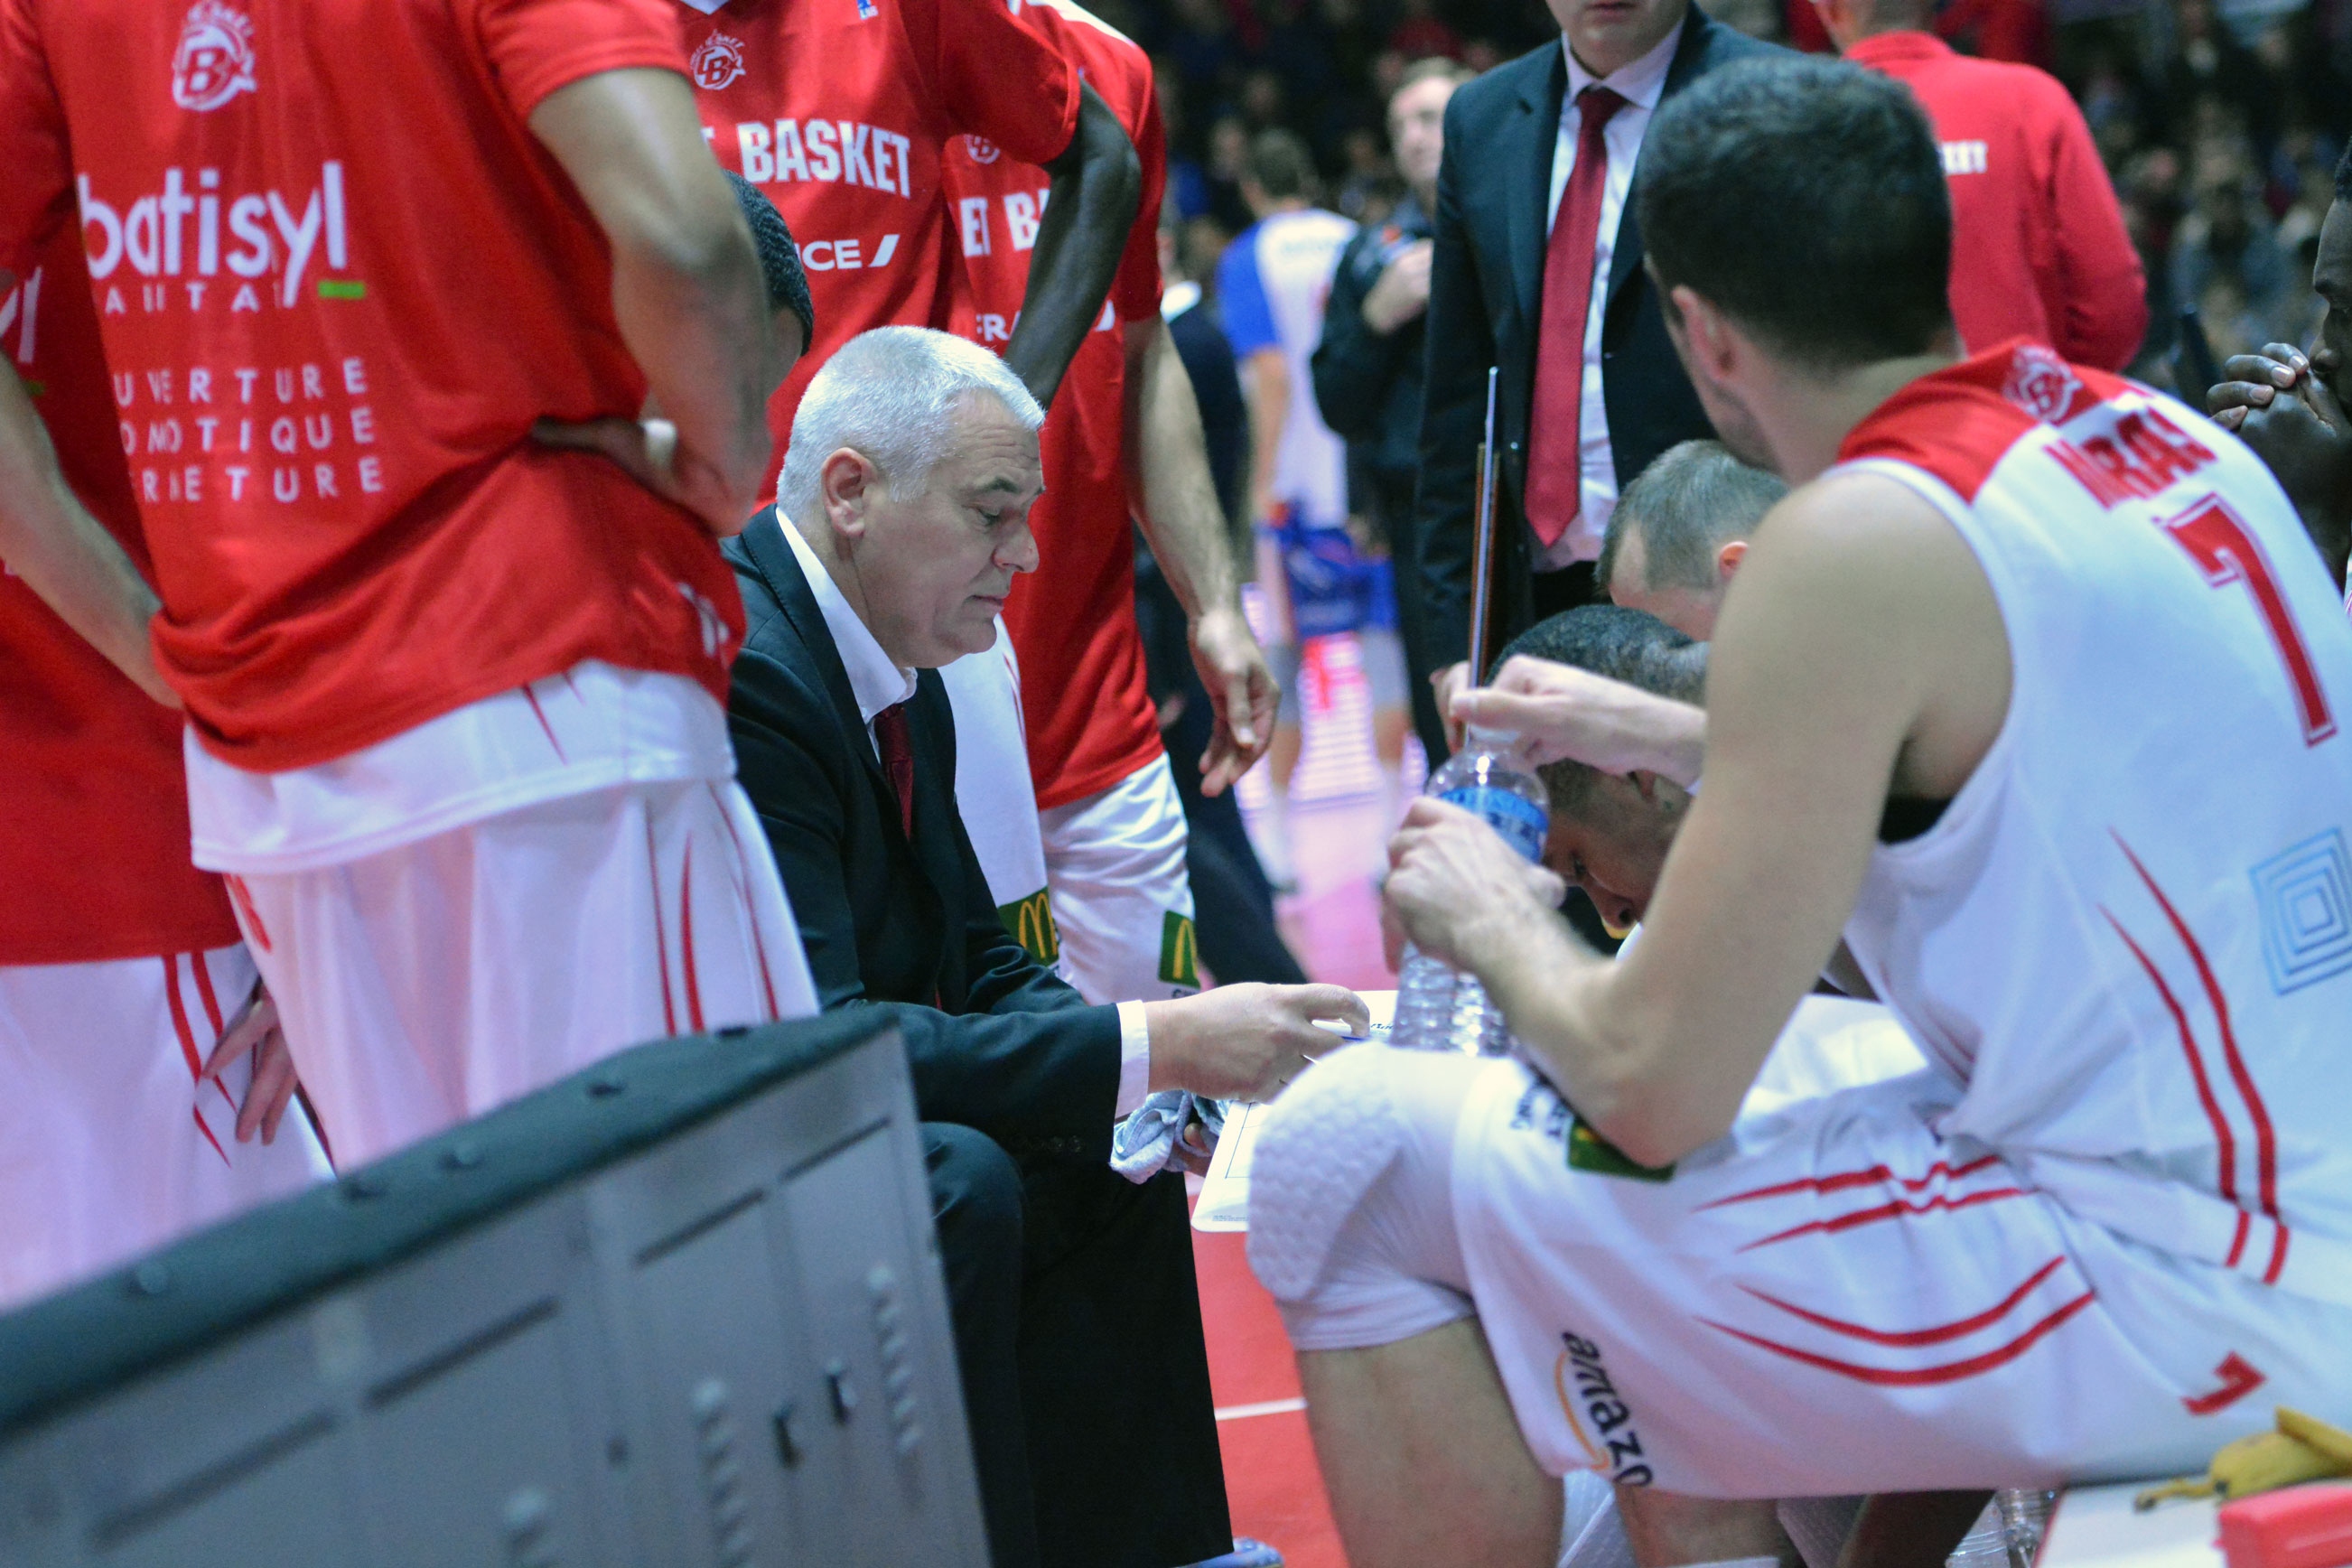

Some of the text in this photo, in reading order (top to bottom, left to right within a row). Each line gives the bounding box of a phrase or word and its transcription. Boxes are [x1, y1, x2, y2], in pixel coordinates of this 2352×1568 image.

[736, 118, 910, 200] BASKET
[77, 160, 347, 309] batisyl
[795, 239, 862, 271] CE
[2151, 491, 2339, 750] 7
[2179, 1349, 2267, 1417] 7
